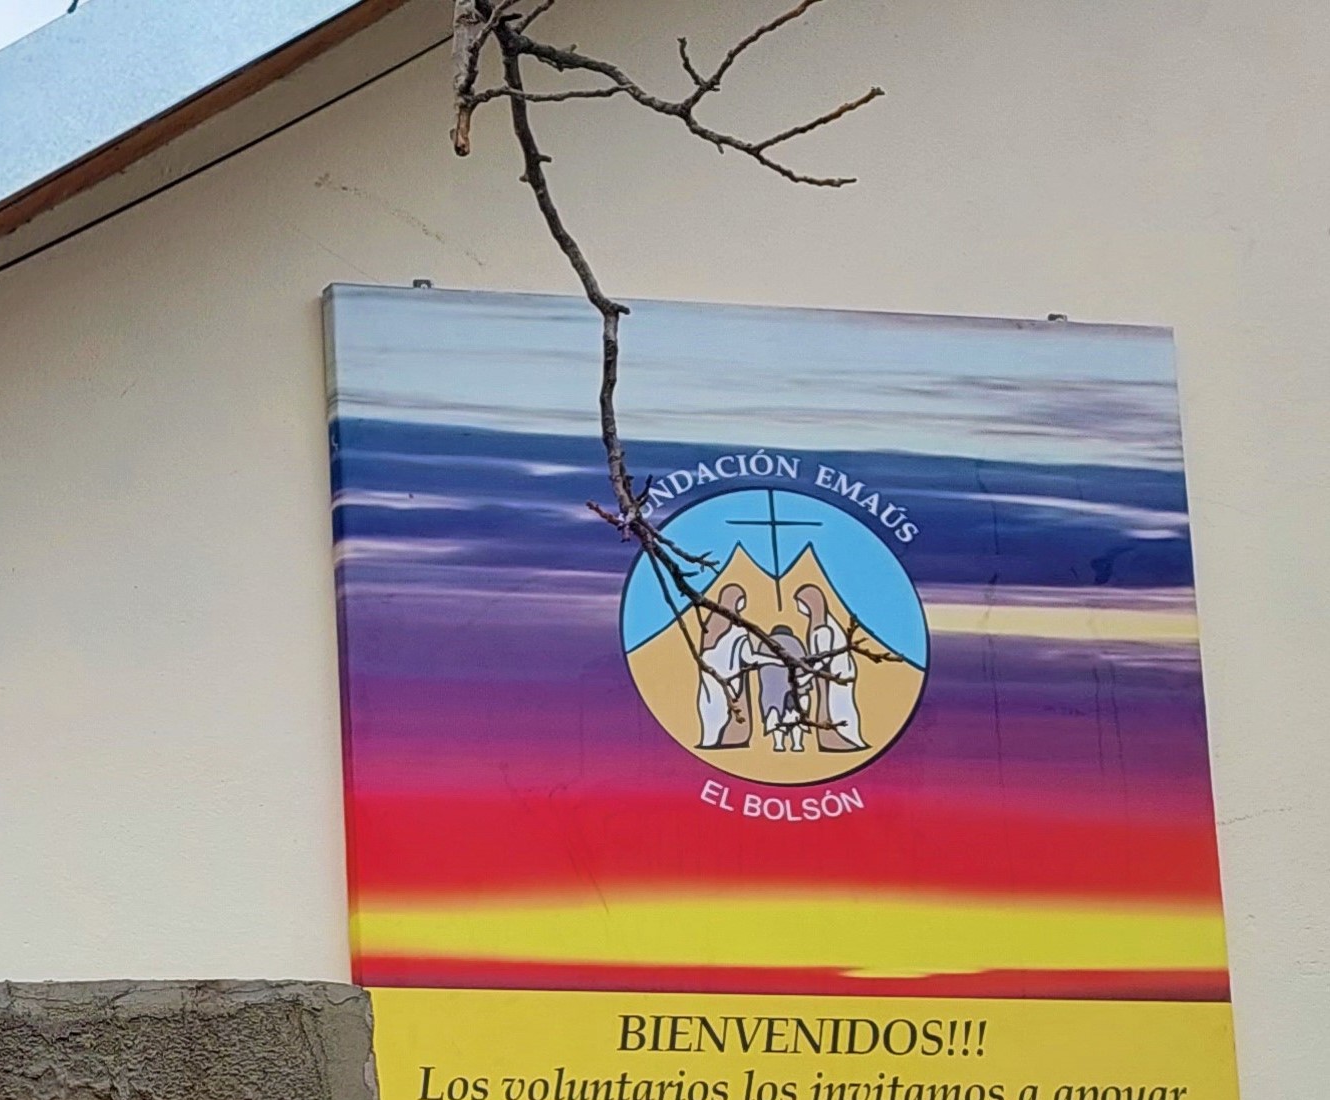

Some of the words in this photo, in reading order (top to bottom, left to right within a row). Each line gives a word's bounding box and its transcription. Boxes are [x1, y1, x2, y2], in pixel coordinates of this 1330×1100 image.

[814, 465, 920, 545] EMAÚS
[700, 780, 735, 812] EL
[743, 787, 864, 821] BOLSÓN
[617, 1015, 987, 1056] BIENVENIDOS!!!
